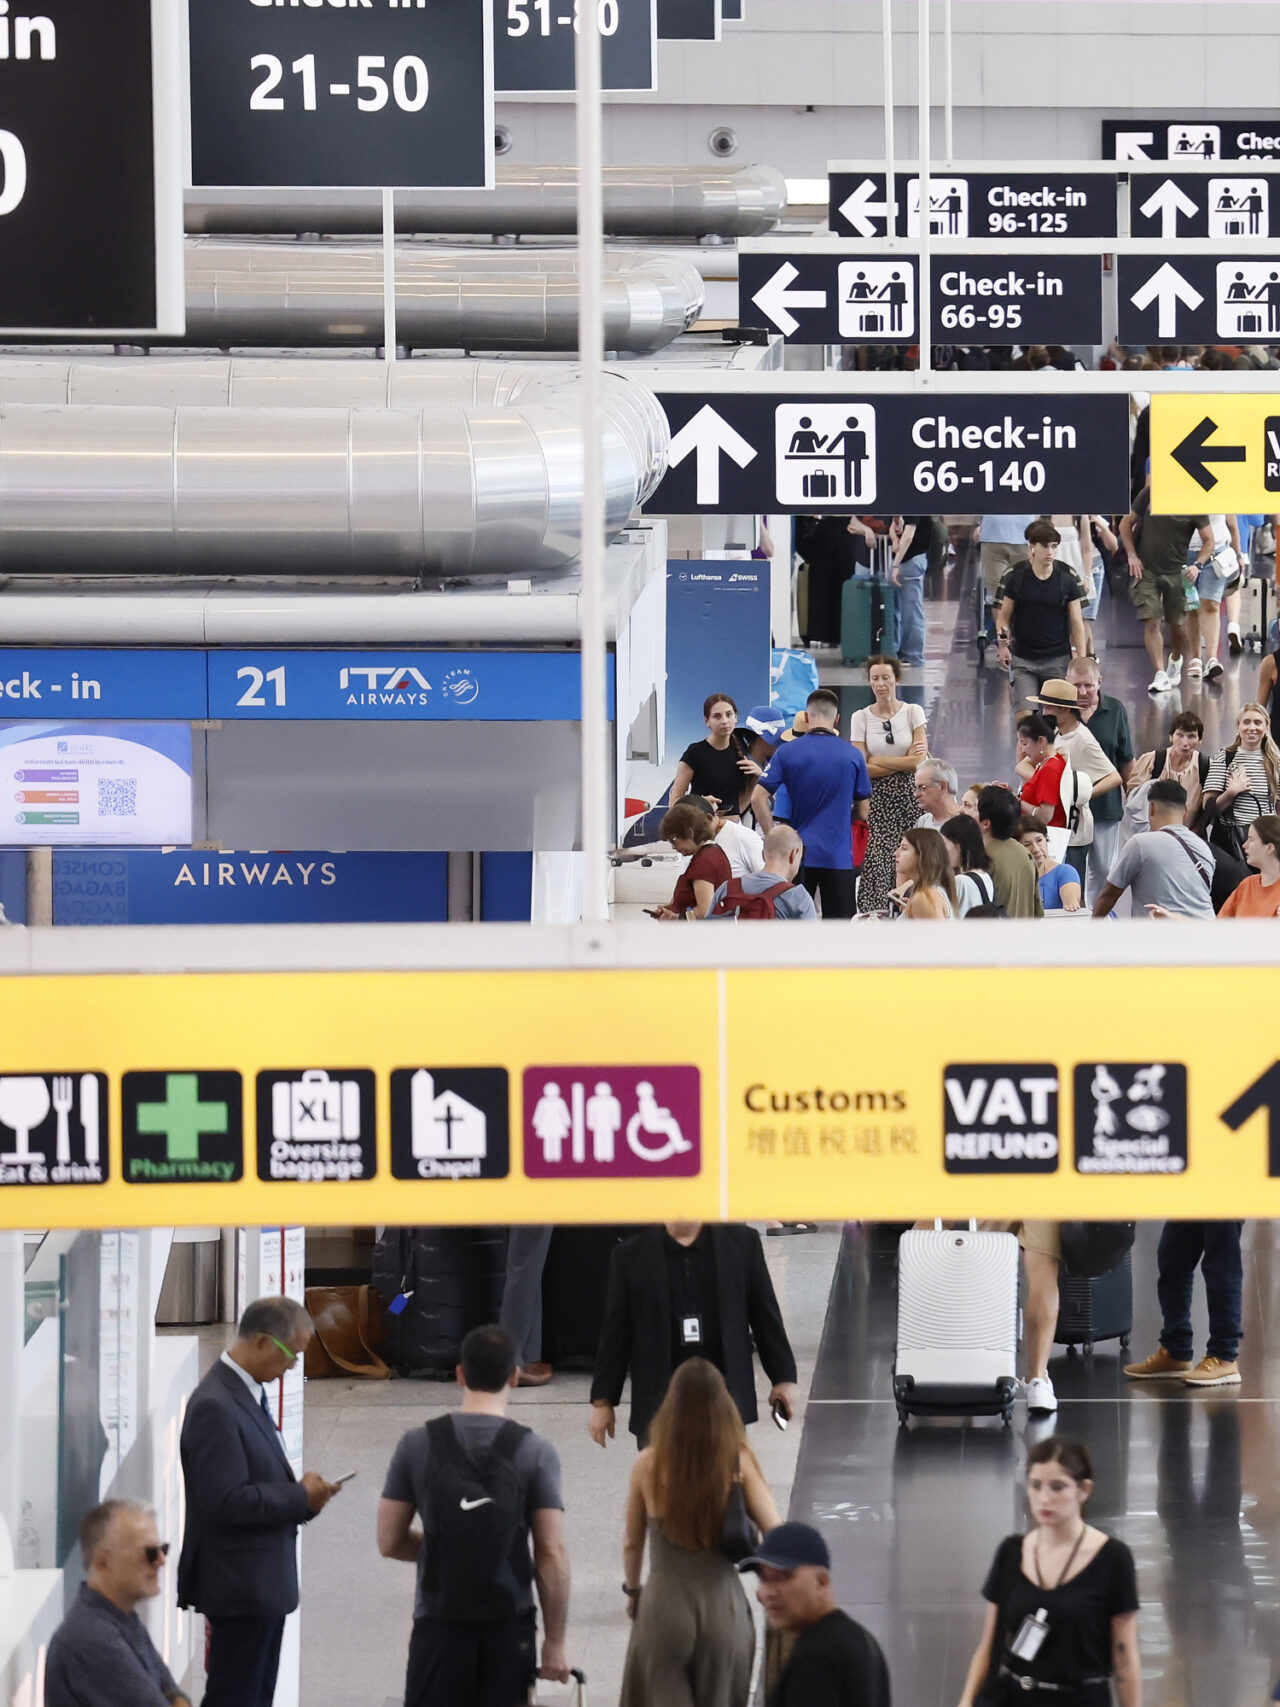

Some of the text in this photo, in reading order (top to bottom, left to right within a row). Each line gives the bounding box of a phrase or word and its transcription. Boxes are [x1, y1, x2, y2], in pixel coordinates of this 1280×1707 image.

[249, 54, 429, 111] 21-50
[987, 186, 1087, 207] Check-in
[988, 213, 1068, 233] 96-125
[940, 271, 1064, 297] Check-in
[940, 305, 1022, 329] 66-95
[911, 416, 1077, 449] Check-in
[913, 460, 1046, 493] 66-140
[690, 573, 722, 581] Lufthansa
[72, 672, 101, 699] in
[236, 666, 286, 706] 21
[340, 667, 432, 690] ITA
[346, 693, 428, 705] AIRWAYS
[174, 862, 337, 886] AIRWAYS
[744, 1083, 908, 1113] Customs
[945, 1078, 1058, 1125] VAT
[270, 1140, 362, 1162] Oversize
[945, 1132, 1058, 1160] REFUND
[51, 1162, 103, 1182] drink
[129, 1158, 235, 1181] Pharmacy
